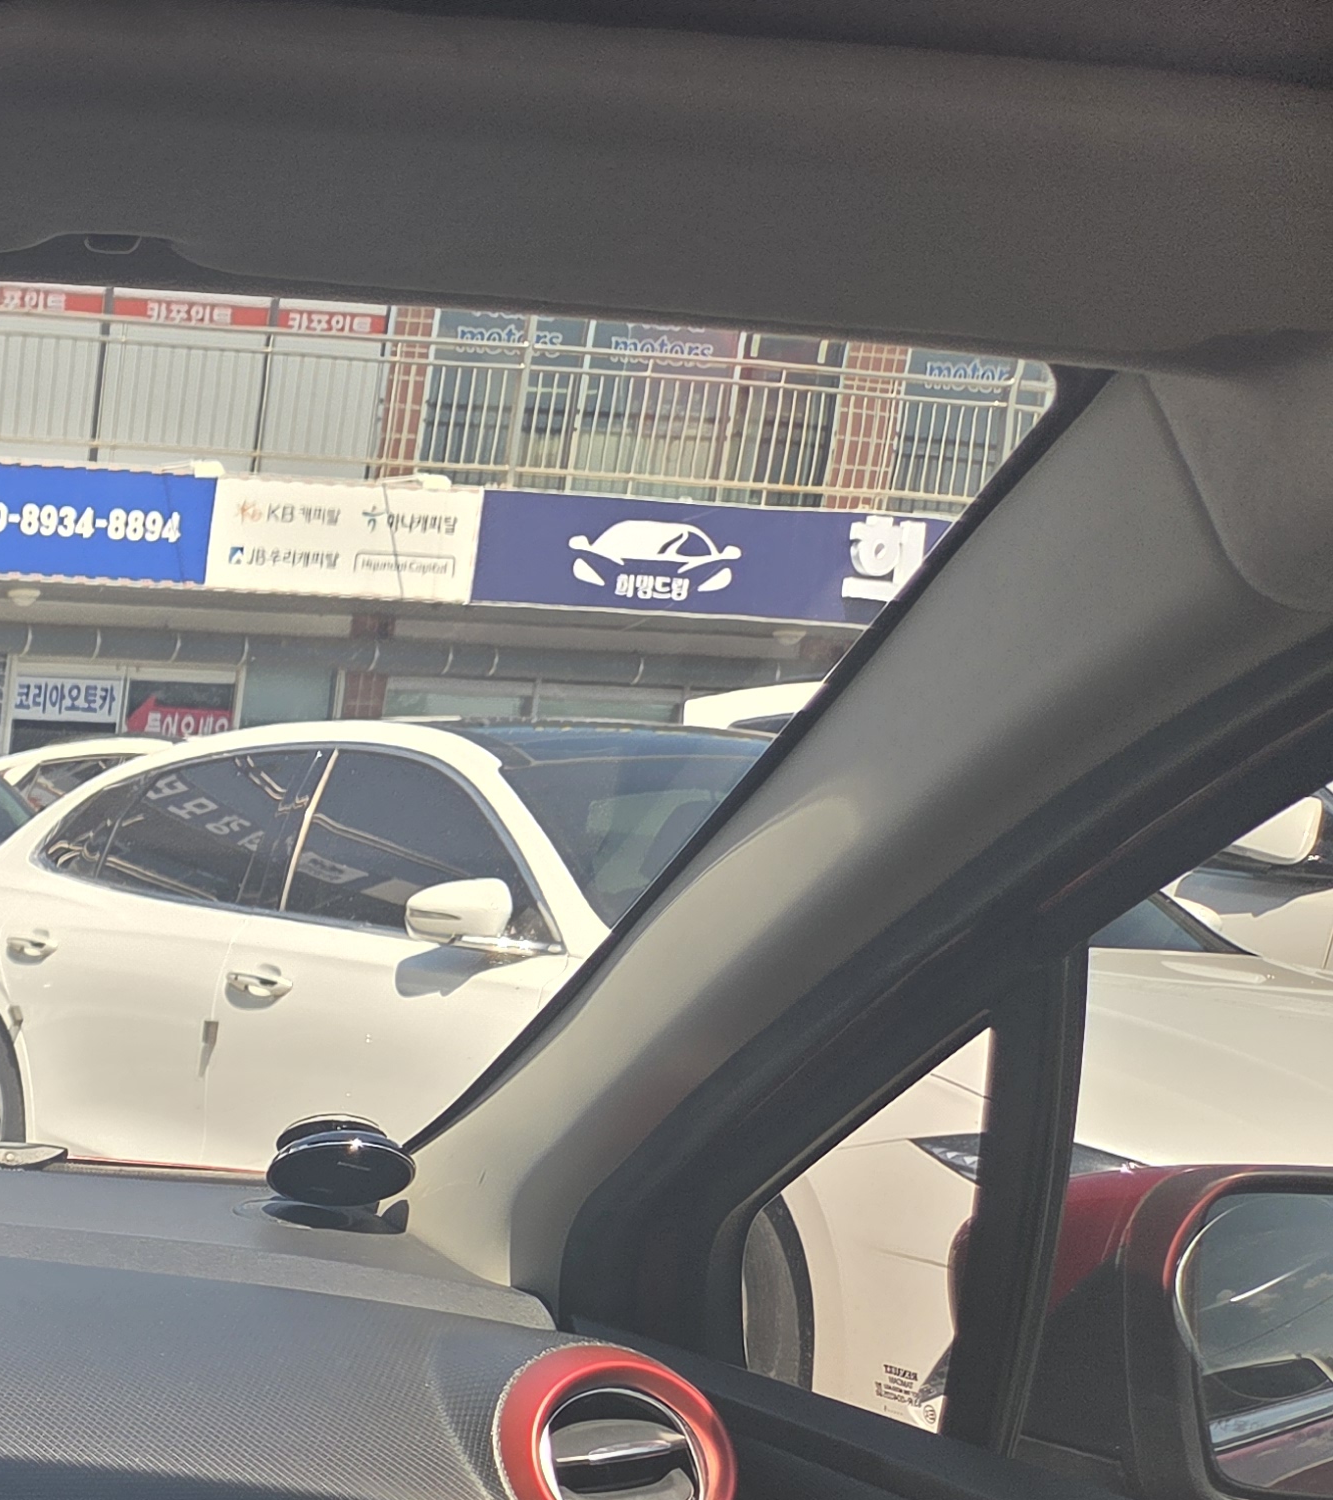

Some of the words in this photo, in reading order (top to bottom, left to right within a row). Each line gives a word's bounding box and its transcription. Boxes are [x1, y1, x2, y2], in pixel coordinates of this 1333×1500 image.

[610, 335, 714, 368] motors
[925, 359, 1009, 393] motor
[265, 502, 295, 523] KB
[14, 681, 116, 717] 코리아오토카
